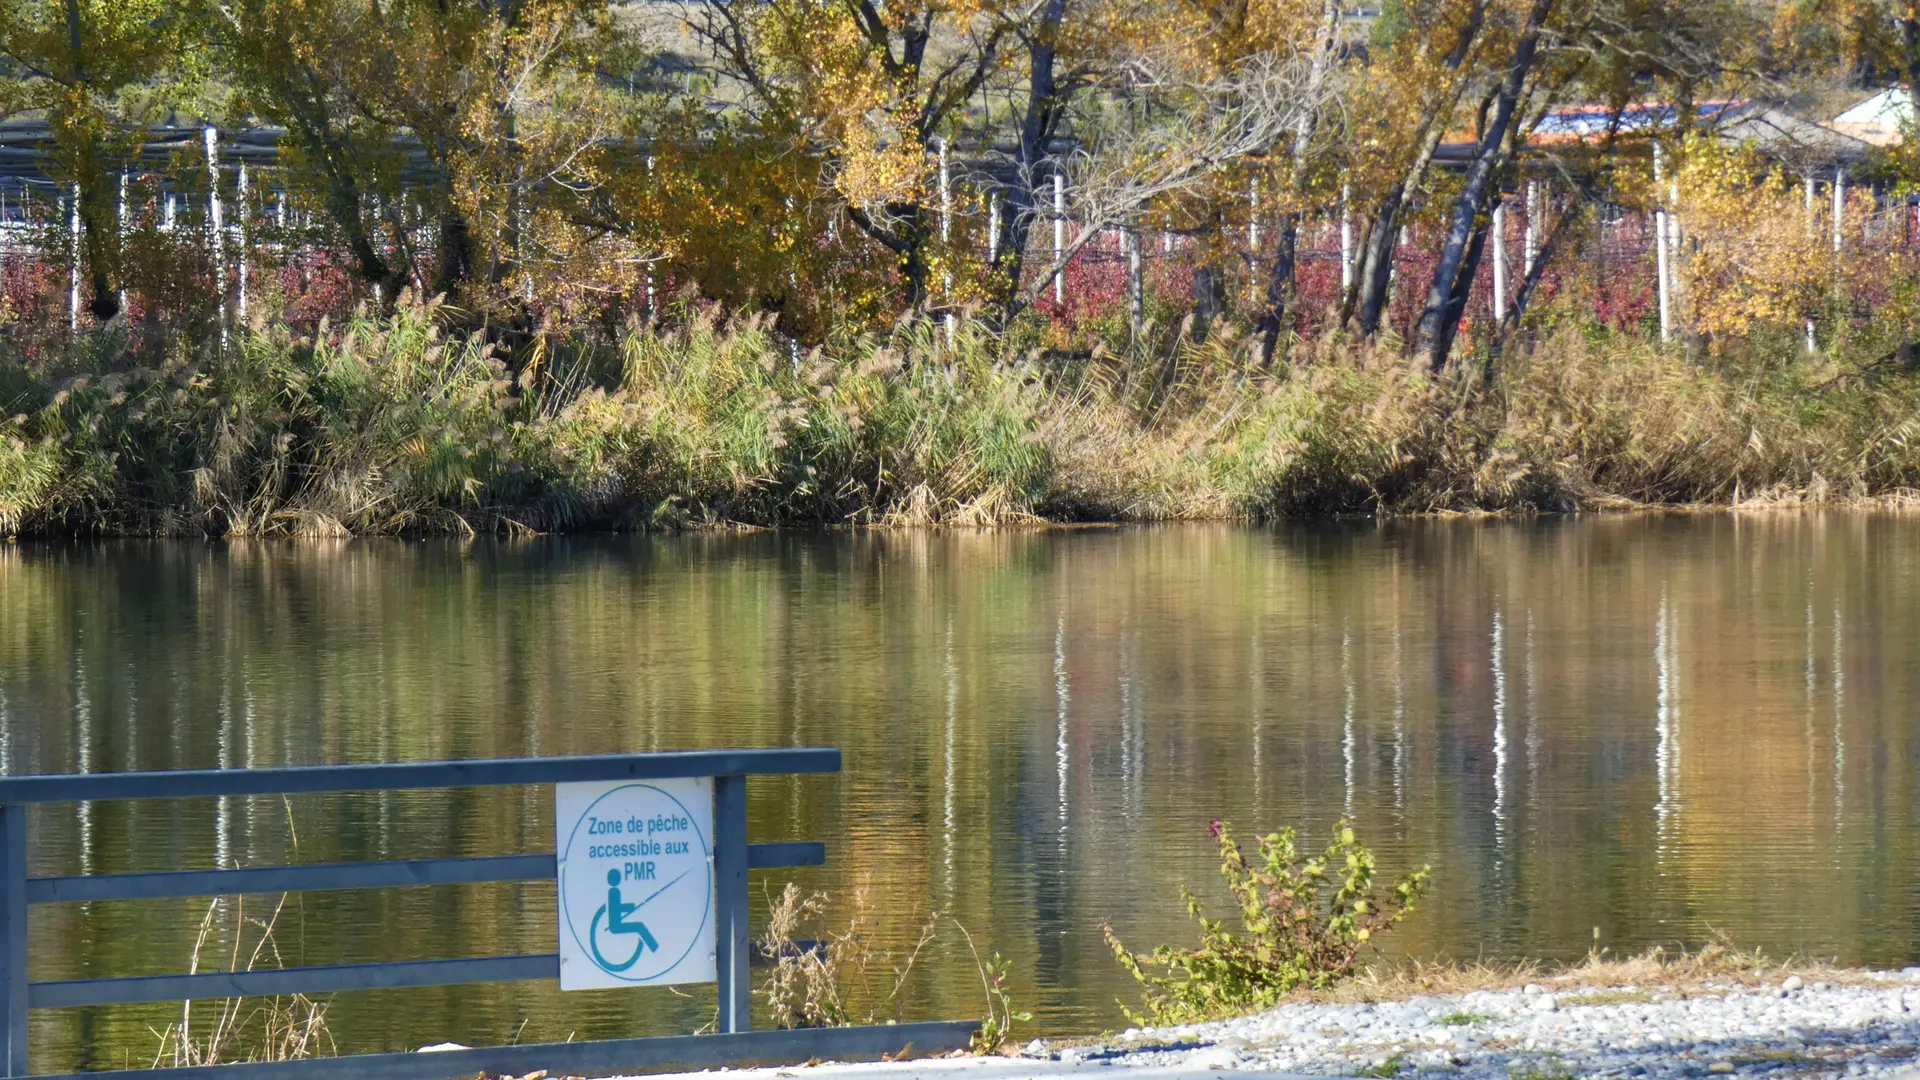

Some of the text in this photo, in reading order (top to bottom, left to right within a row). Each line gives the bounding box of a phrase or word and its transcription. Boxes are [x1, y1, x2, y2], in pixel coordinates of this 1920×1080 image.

[588, 813, 689, 836] Zone de pêche
[588, 839, 689, 858] accessible aux
[624, 861, 656, 881] PMR
